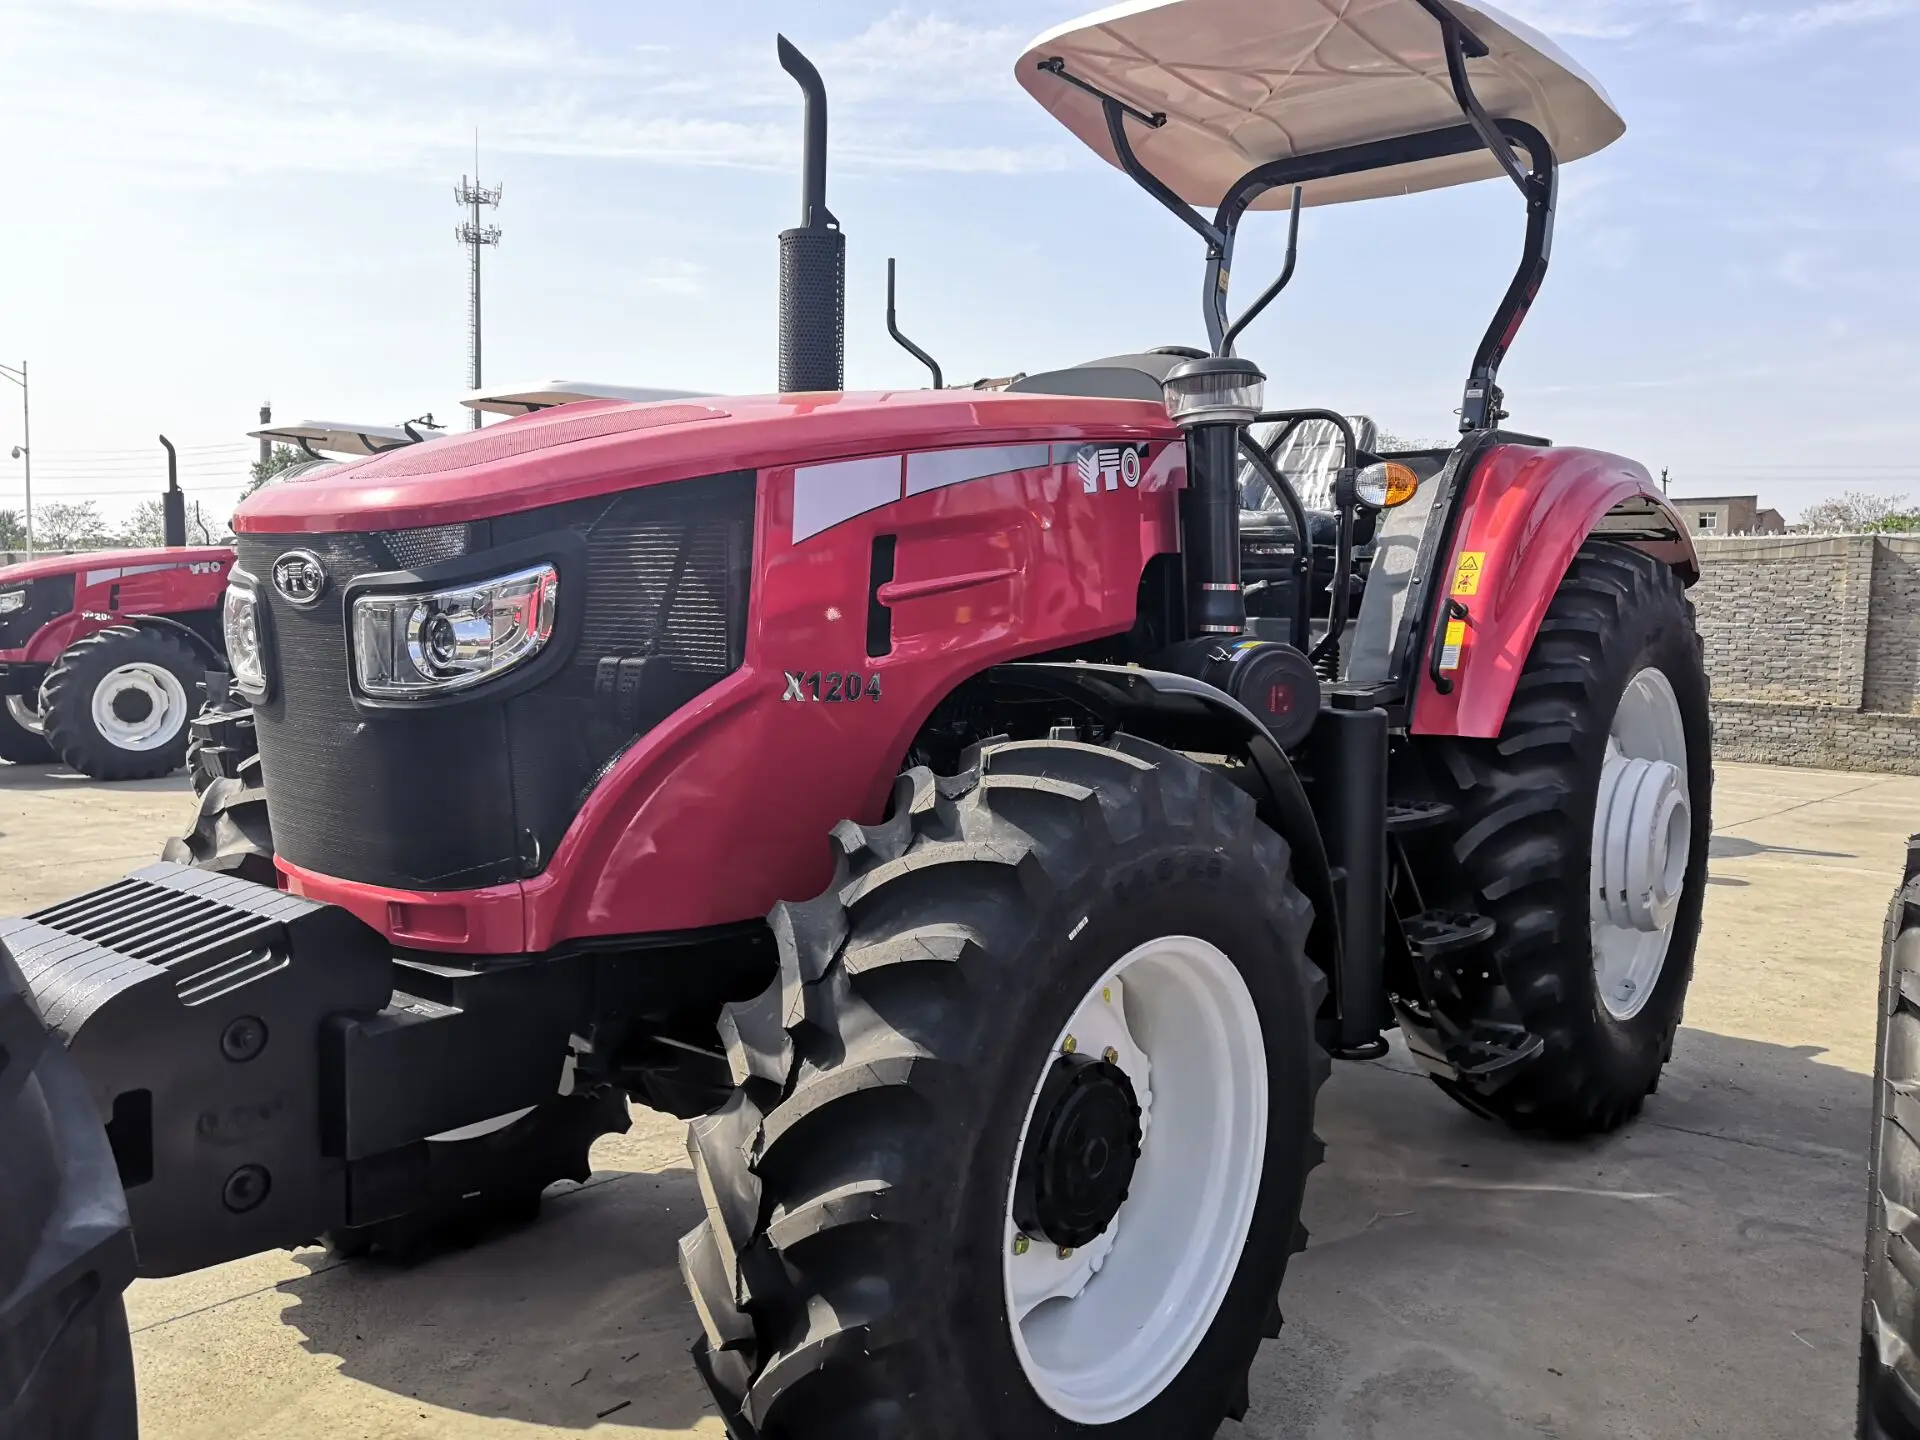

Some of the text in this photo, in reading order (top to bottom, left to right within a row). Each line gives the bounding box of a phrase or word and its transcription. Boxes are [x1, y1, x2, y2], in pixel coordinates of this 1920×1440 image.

[1077, 447, 1140, 493] YTO
[189, 561, 220, 575] YTO
[781, 669, 882, 703] X1204
